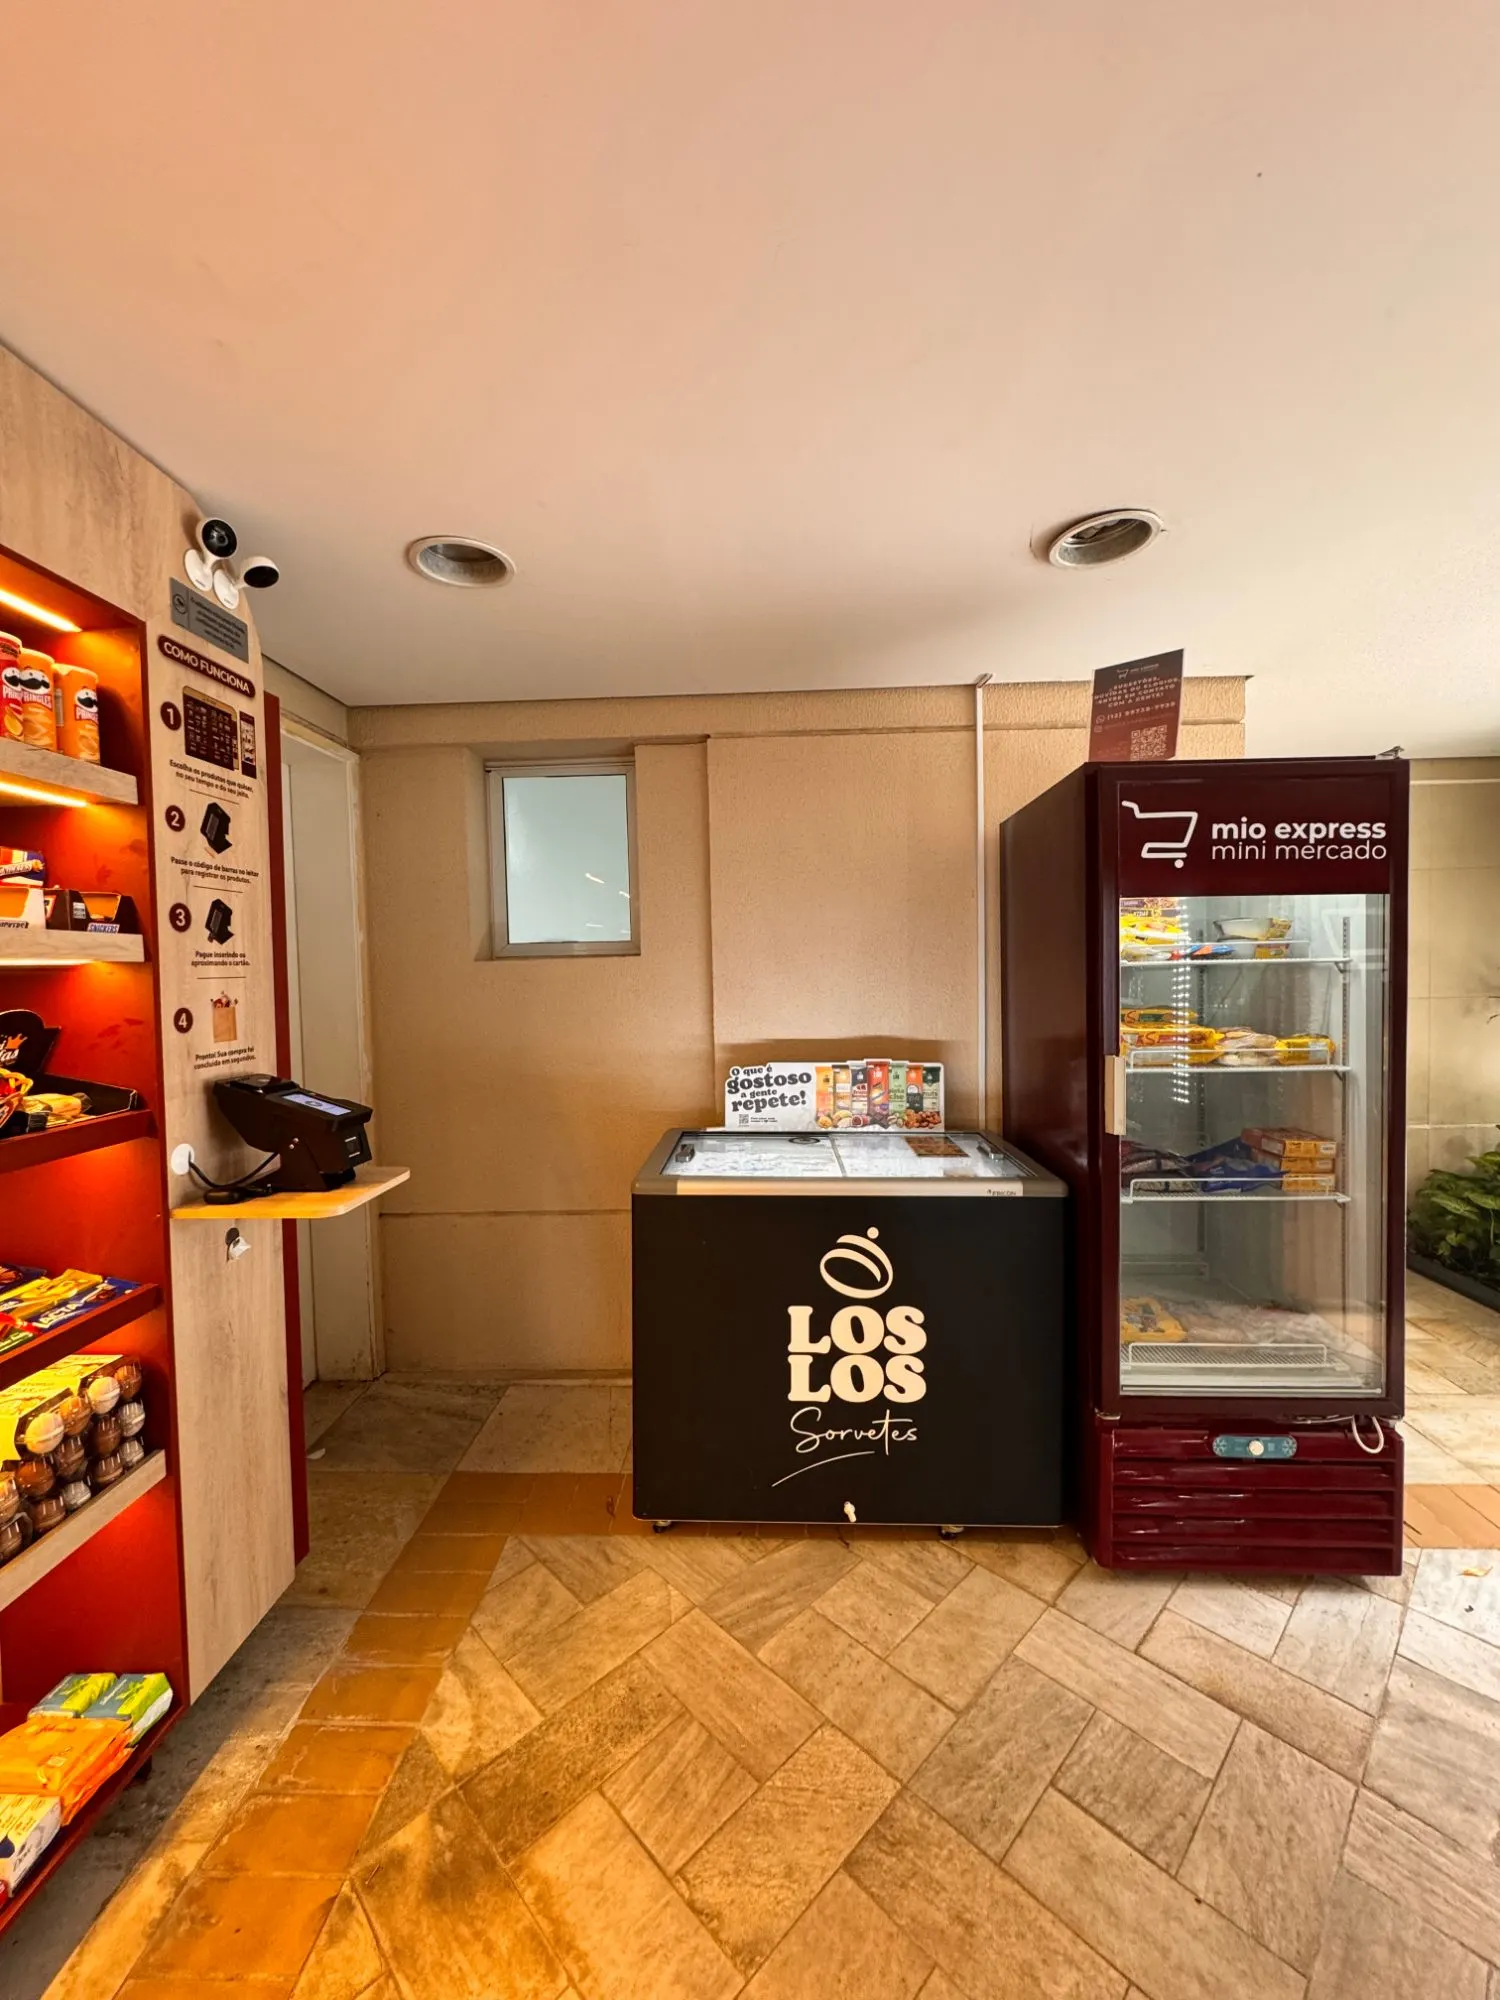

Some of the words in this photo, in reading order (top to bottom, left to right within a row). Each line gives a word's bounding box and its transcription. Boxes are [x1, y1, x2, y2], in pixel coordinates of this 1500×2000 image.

[163, 641, 199, 668] COMO
[200, 659, 251, 694] FUNCIONA
[166, 707, 176, 725] 1
[169, 759, 193, 772] Escolha
[201, 770, 226, 783] produtos
[226, 779, 237, 787] que
[184, 774, 196, 782] seu
[170, 810, 180, 827] 2
[1211, 816, 1267, 840] mio
[1274, 821, 1387, 844] express
[1211, 840, 1267, 860] mini
[1274, 840, 1387, 860] mercado
[180, 868, 194, 876] para
[194, 869, 219, 879] registrar
[193, 861, 213, 871] código
[221, 865, 238, 874] barras
[175, 908, 186, 927] 3
[88, 924, 119, 934] SNICKERS
[195, 950, 213, 960] Pague
[191, 960, 228, 968] aproximando
[177, 1012, 188, 1029] 4
[217, 1050, 228, 1058] Sua
[227, 1048, 247, 1056] compra
[743, 1067, 763, 1077] que
[766, 1064, 773, 1073] é
[727, 1072, 812, 1094] gostoso
[731, 1090, 807, 1113] repete!
[749, 1089, 777, 1099] gente
[787, 1305, 927, 1355] LOS
[787, 1354, 927, 1403] LOS
[790, 1406, 918, 1456] Sorvetes
